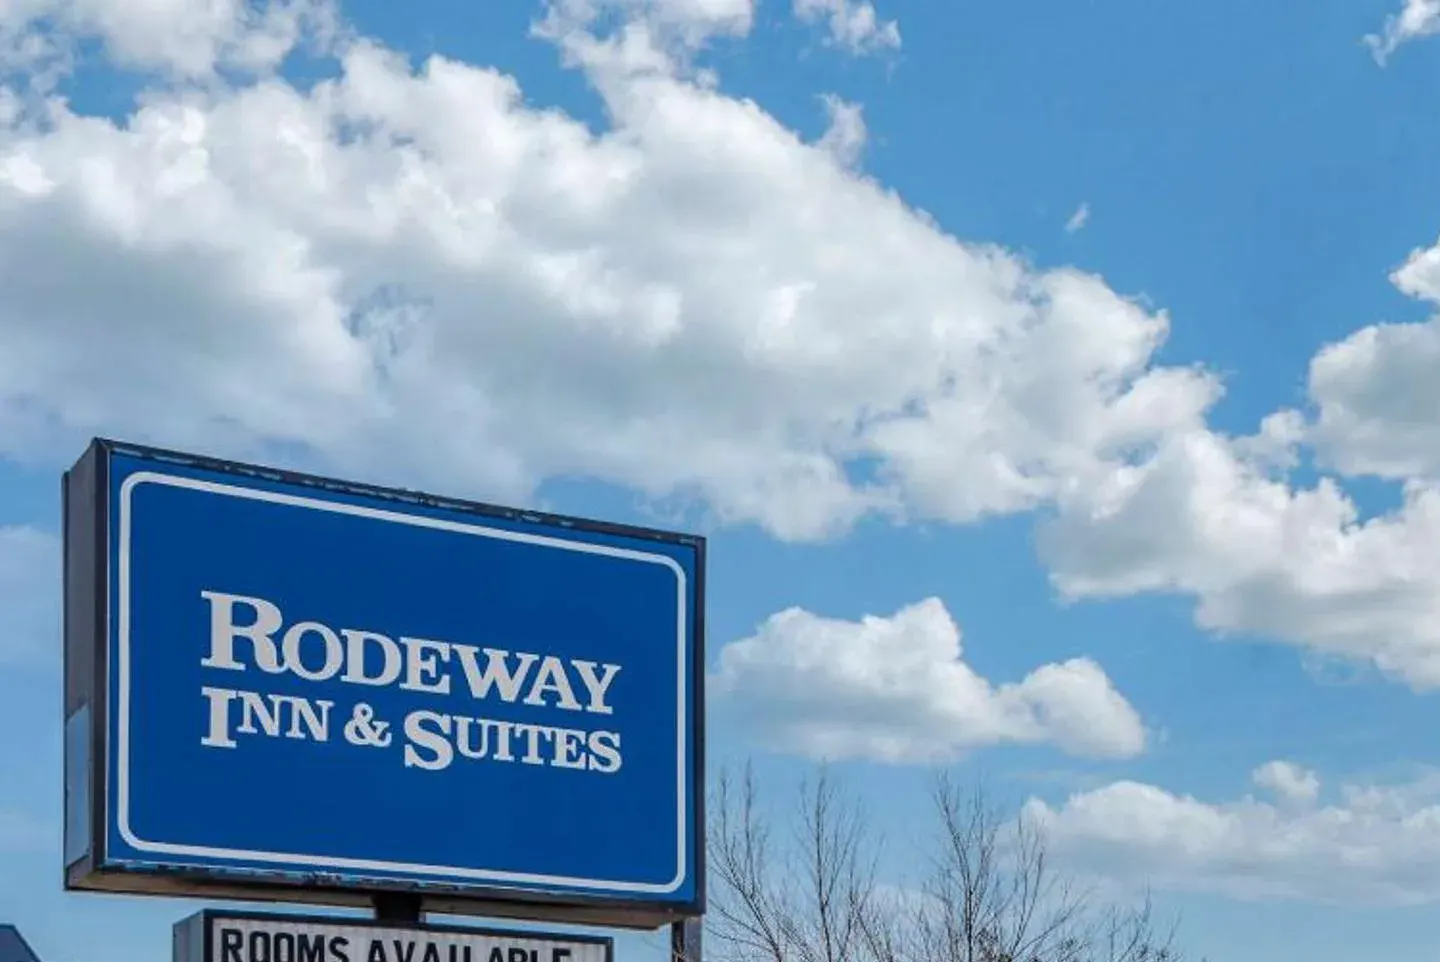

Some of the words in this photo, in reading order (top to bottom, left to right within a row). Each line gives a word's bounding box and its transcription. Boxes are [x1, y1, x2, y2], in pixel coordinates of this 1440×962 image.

[200, 590, 622, 715] RODEWAY
[201, 686, 334, 749] INN
[343, 703, 392, 748] &
[403, 710, 623, 774] SUITES
